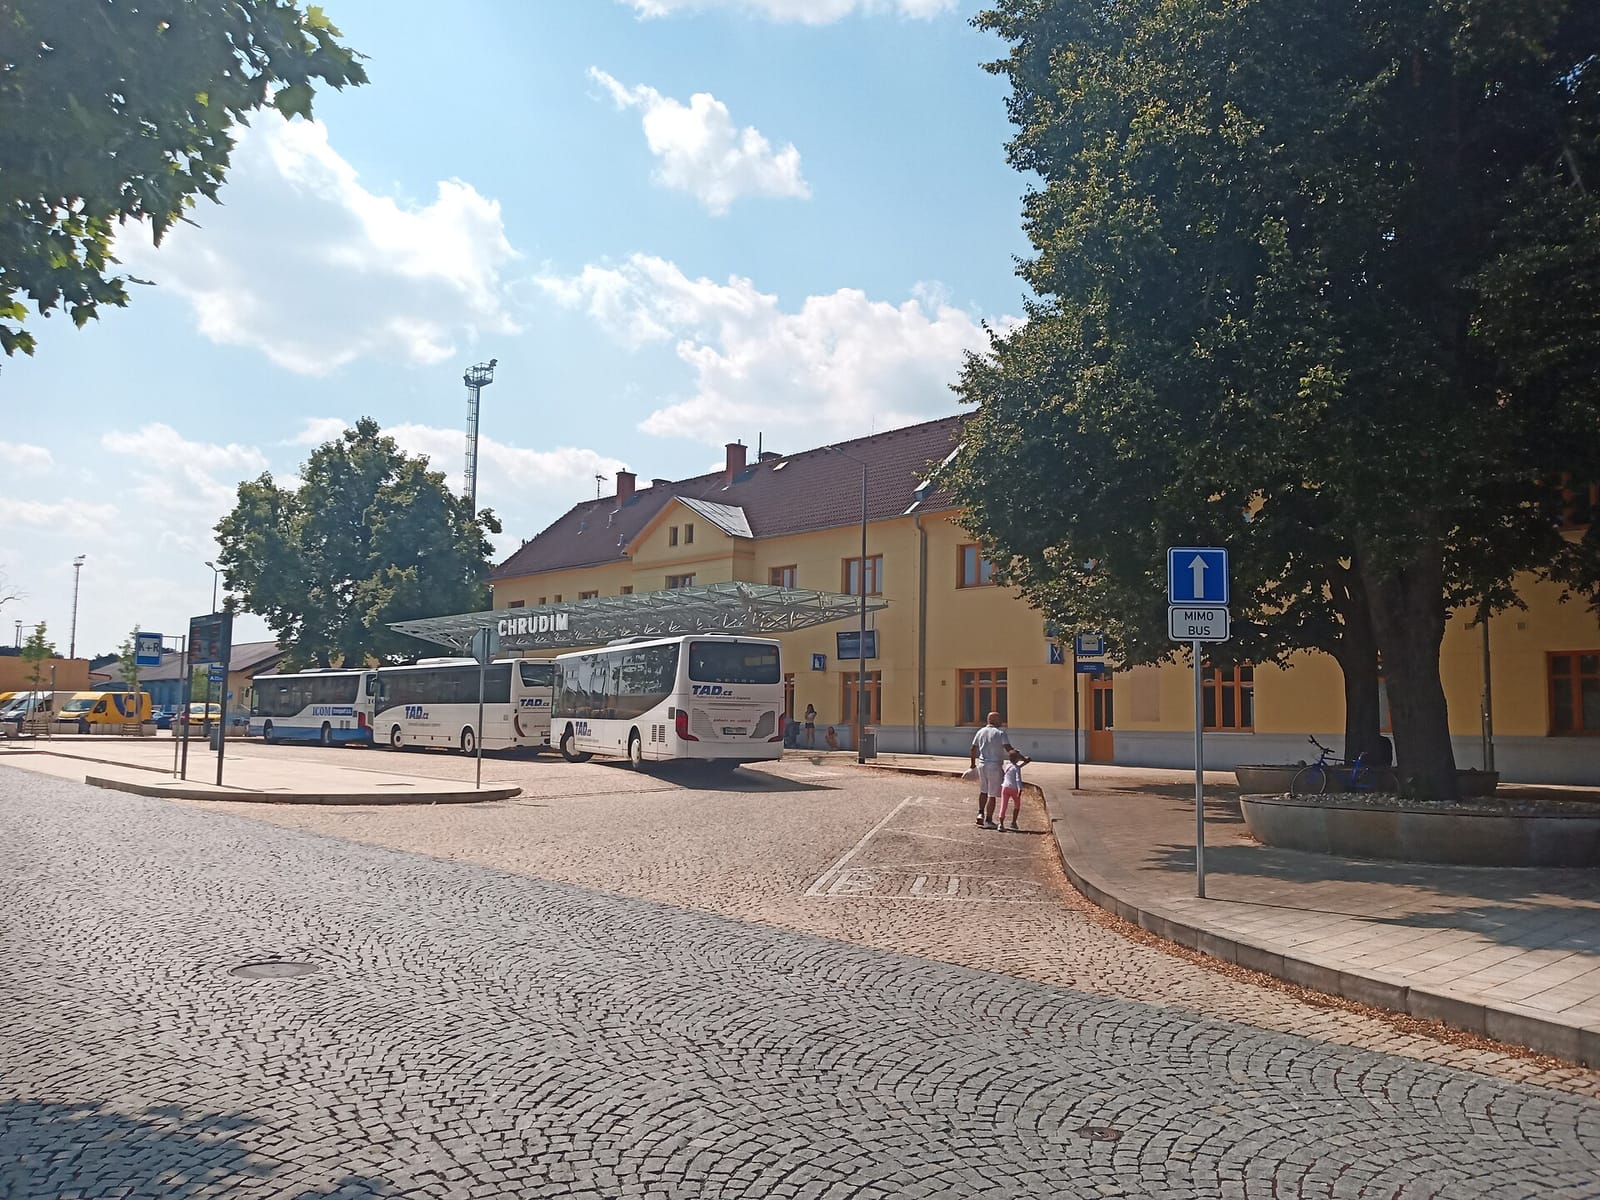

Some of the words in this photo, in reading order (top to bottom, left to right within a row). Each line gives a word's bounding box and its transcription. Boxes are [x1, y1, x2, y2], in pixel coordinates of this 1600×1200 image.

[1184, 611, 1214, 621] MIMO
[498, 613, 569, 636] CHRUDIM
[1188, 625, 1211, 635] BUS
[139, 642, 160, 652] K+R
[692, 685, 733, 696] TAD.cz
[312, 706, 331, 716] ICOM
[826, 872, 1041, 898] BUS
